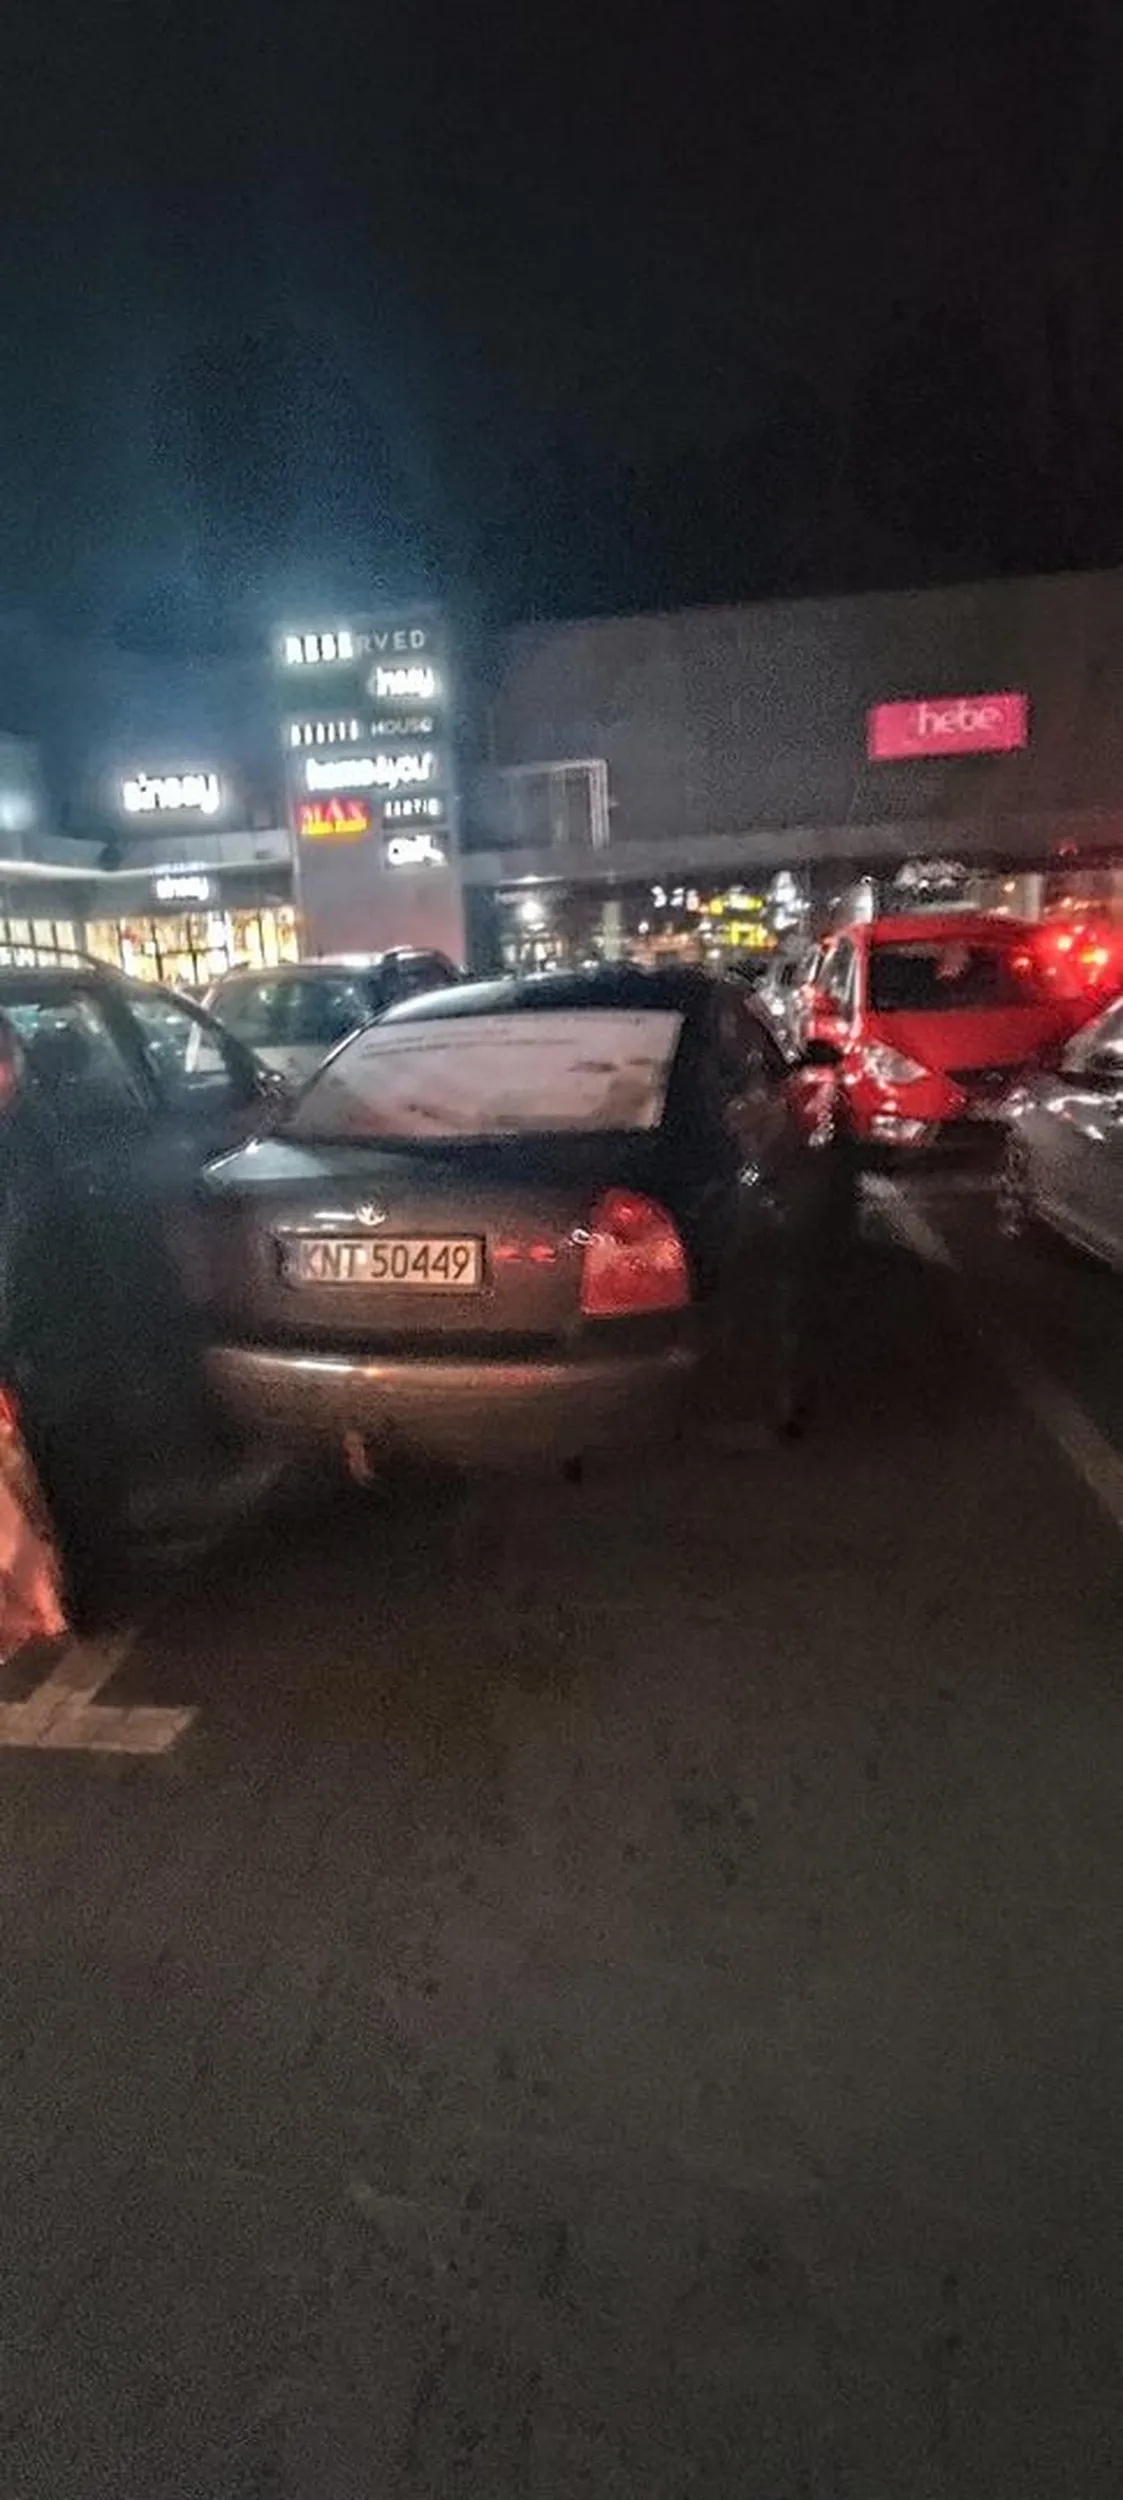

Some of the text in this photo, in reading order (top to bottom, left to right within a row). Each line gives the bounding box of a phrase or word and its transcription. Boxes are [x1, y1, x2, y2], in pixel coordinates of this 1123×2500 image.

[918, 701, 1004, 736] hebe
[303, 1239, 471, 1280] KNT 50449
